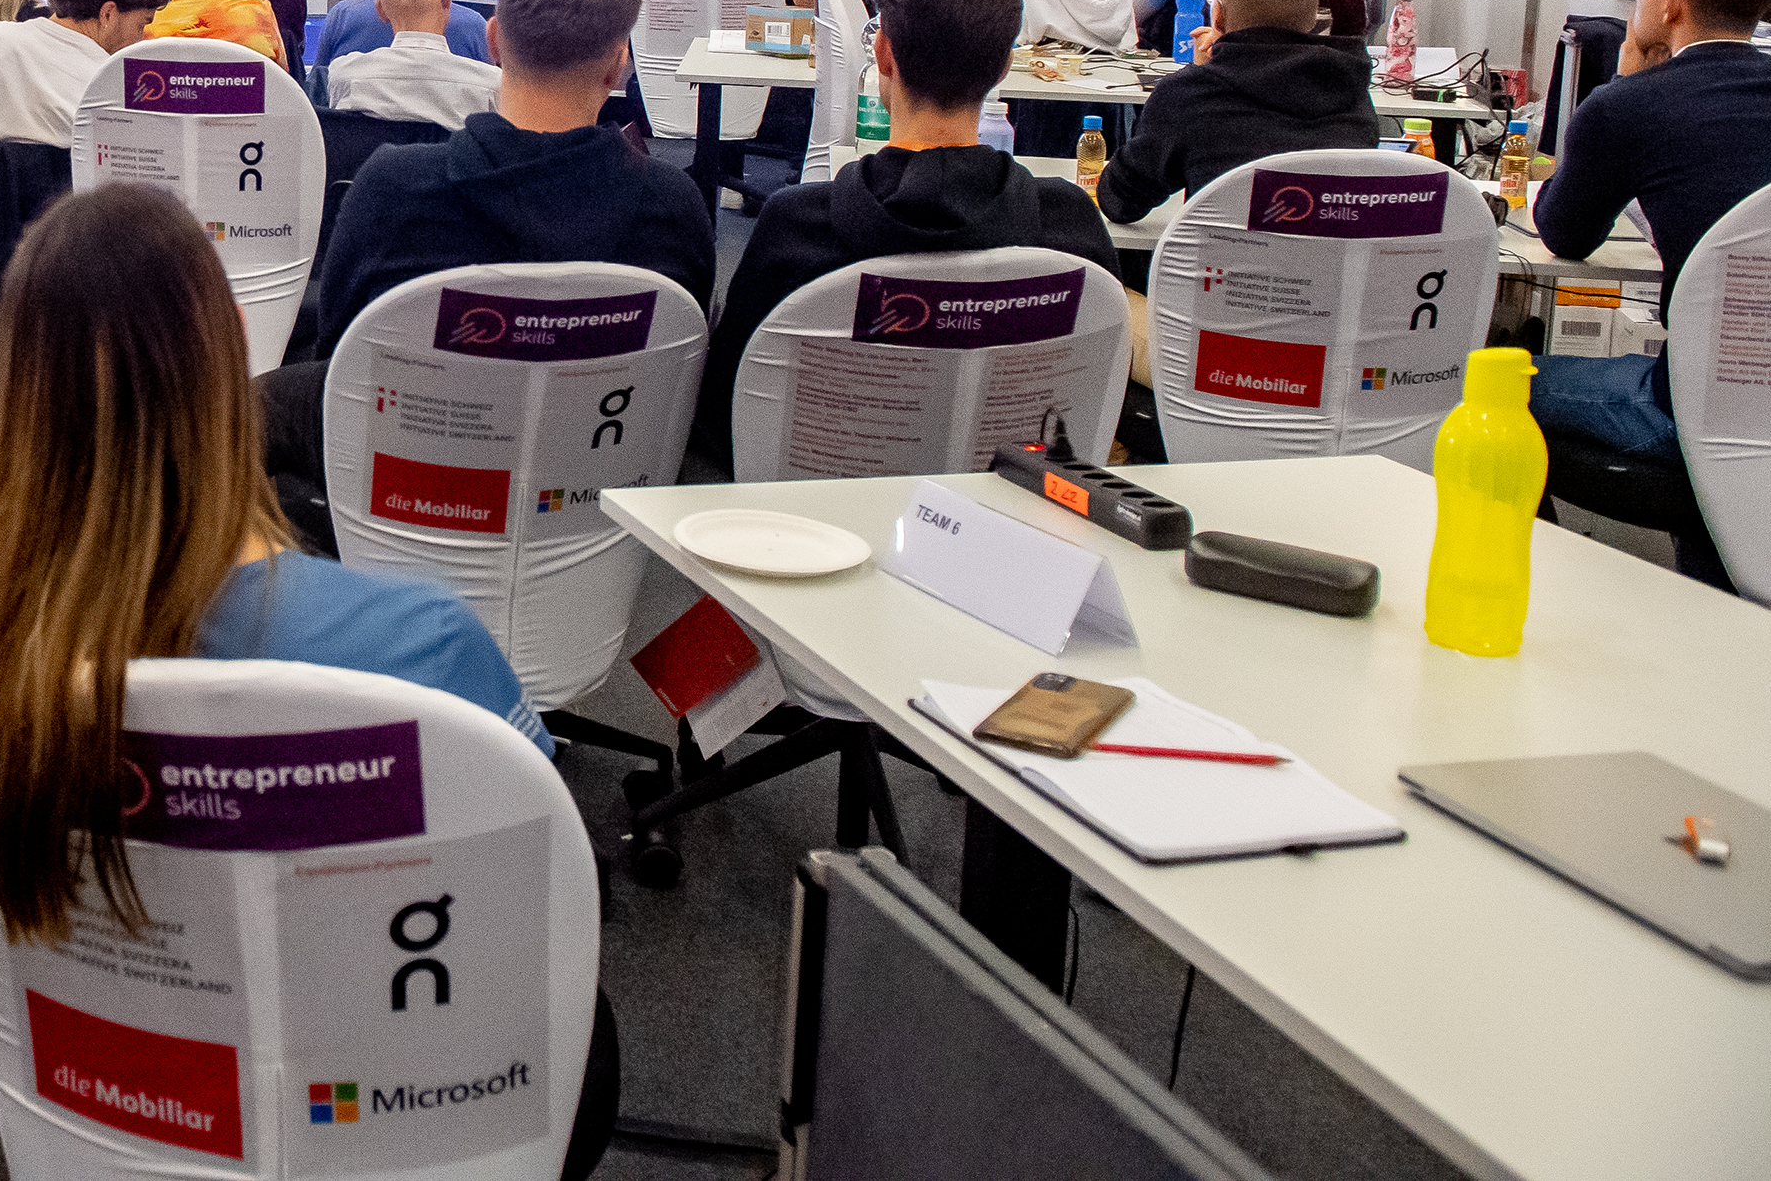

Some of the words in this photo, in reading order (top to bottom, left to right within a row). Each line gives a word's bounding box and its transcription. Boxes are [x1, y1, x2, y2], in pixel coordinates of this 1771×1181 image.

[169, 74, 256, 88] entrepreneur
[169, 88, 198, 100] skills
[1321, 190, 1437, 207] entrepreneur
[1319, 208, 1359, 221] skills
[229, 223, 292, 238] Microsoft
[1228, 270, 1270, 283] INITIATIVE
[1272, 276, 1312, 286] SCHWEIZ
[1226, 280, 1270, 293] INITIATIVE
[1271, 285, 1301, 296] SUISSE
[938, 288, 1072, 315] entrepreneur
[1225, 300, 1269, 313] INITIATIVE
[1270, 306, 1331, 317] SWITZERLAND
[1271, 295, 1312, 306] SVIZZERA
[515, 308, 642, 330] entrepreneur
[936, 314, 982, 331] skills
[512, 330, 556, 345] skills
[1209, 369, 1234, 385] die
[1235, 374, 1308, 395] Mobiliar
[1390, 364, 1460, 387] Microsoft
[385, 493, 412, 511] die
[414, 498, 492, 521] Mobiliar
[917, 503, 953, 530] TEAM
[951, 521, 962, 536] 6
[160, 755, 396, 794] entrepreneur
[164, 790, 242, 820] skills
[371, 1061, 531, 1115] Microsoft
[53, 1065, 93, 1097] die
[94, 1077, 216, 1133] Mobiliar
